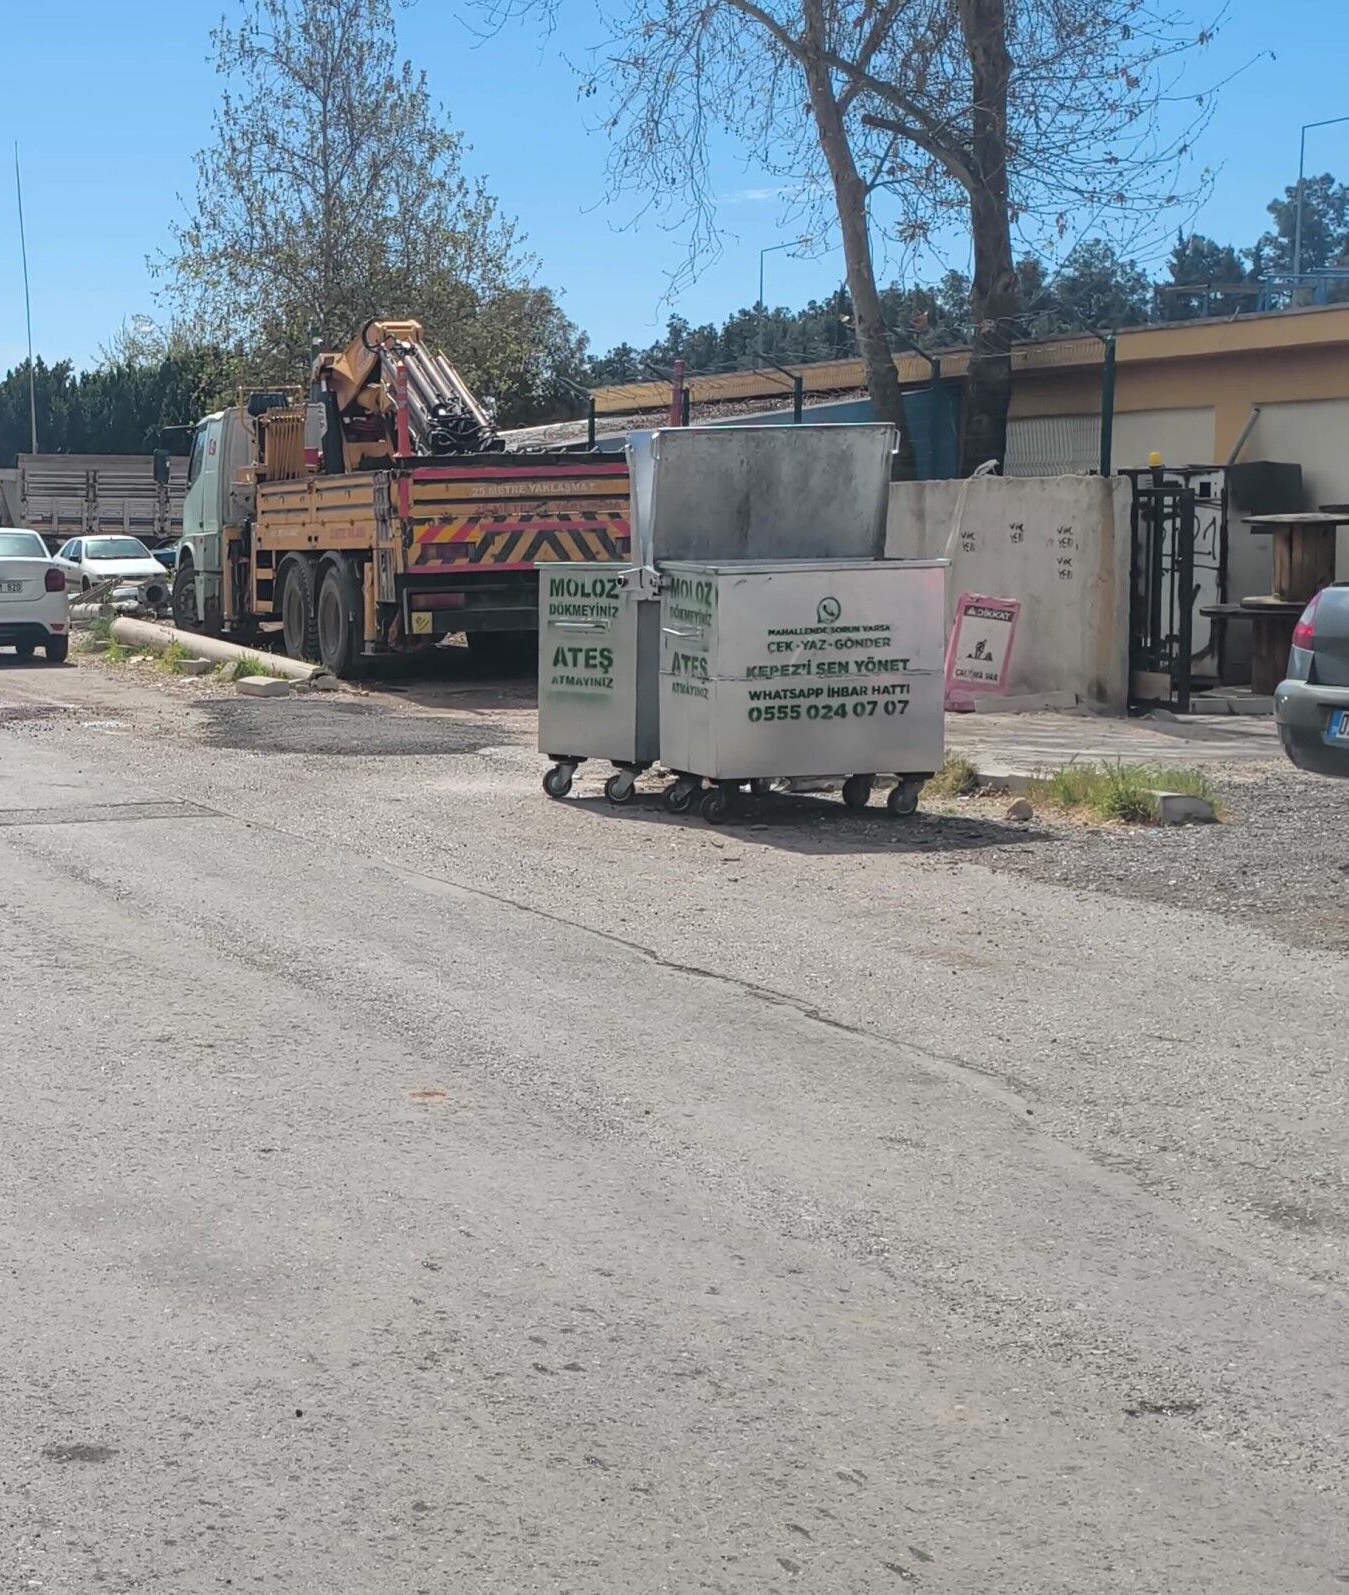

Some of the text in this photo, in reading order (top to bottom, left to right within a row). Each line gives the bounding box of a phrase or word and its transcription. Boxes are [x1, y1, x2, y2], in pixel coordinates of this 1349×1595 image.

[472, 487, 486, 497] 25
[488, 484, 525, 496] METRE
[550, 578, 620, 599] MOLOZ
[670, 577, 713, 606] MOLOZ
[549, 602, 620, 618] DÖKMEYİNİZ
[669, 604, 713, 627] DÖKMEYİNİZ
[768, 624, 891, 637] MAHALLENDE SORUN VARSA
[801, 639, 827, 650] YAZ
[835, 636, 891, 650] GÖNDER
[552, 646, 614, 675] ATEŞ
[671, 651, 709, 684] ATEŞ
[816, 661, 850, 676] SEN
[854, 657, 910, 673] YÖNET
[551, 675, 615, 690] ATMAYINIZ
[748, 684, 911, 701] WHATSAPP İHBAR HATTI
[748, 700, 910, 722] 0555 024 07 07
